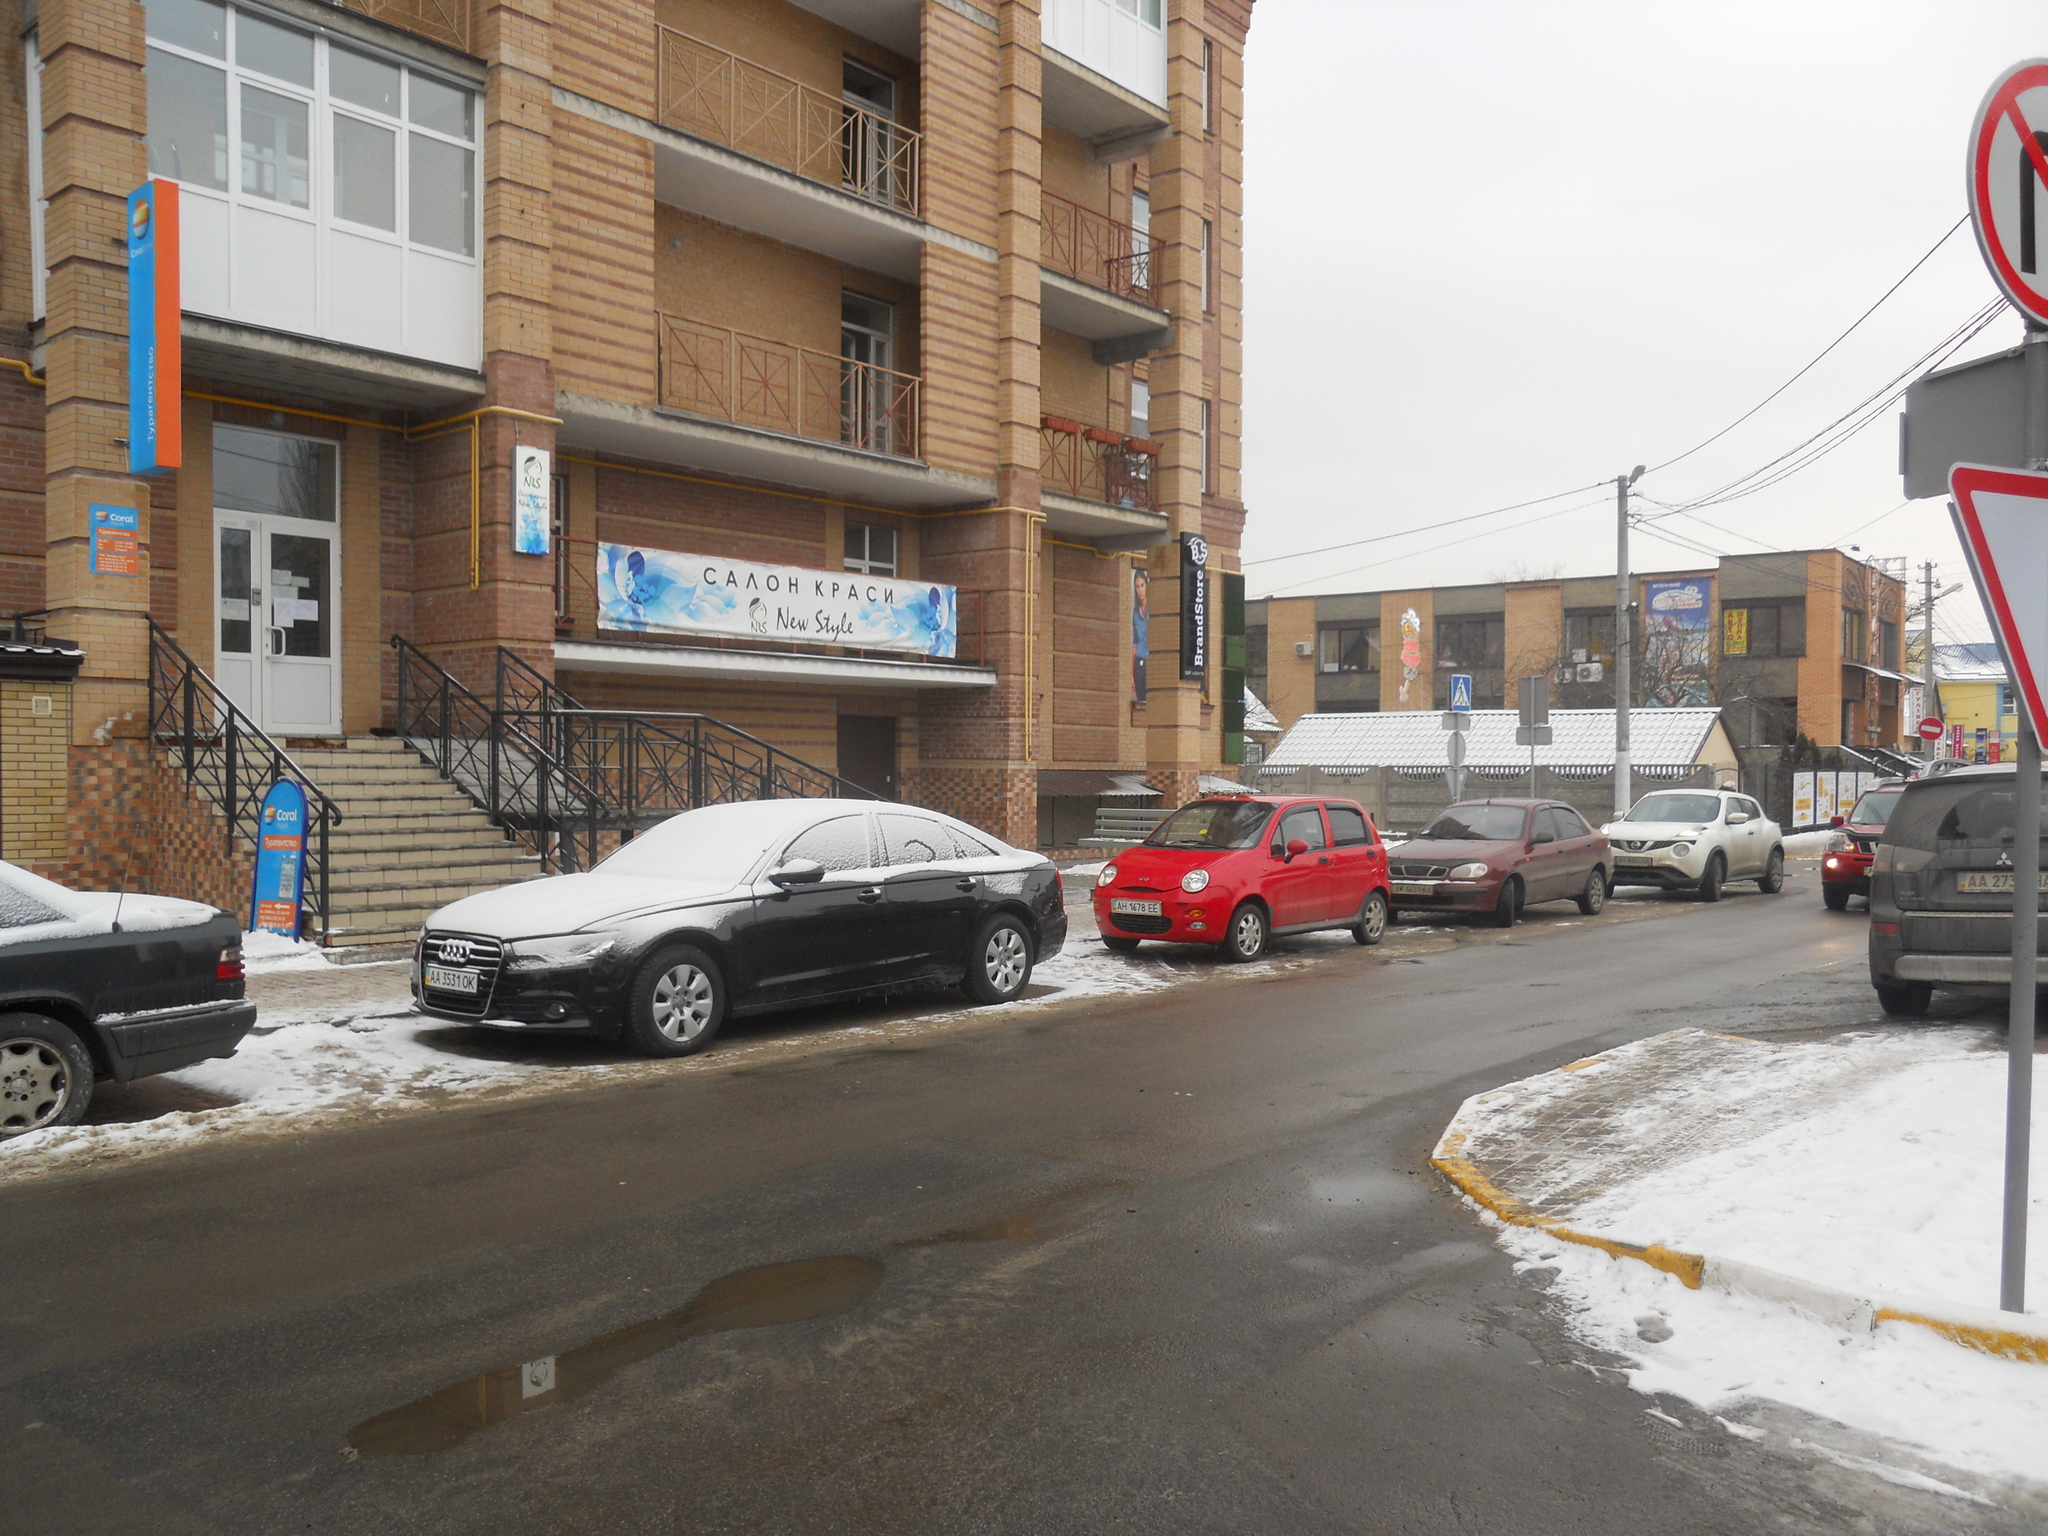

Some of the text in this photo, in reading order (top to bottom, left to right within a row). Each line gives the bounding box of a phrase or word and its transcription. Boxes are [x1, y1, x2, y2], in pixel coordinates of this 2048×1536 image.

[147, 346, 156, 444] Турагентство
[110, 513, 134, 523] Coral
[703, 567, 894, 603] САЛОН КРАСИ
[776, 606, 854, 642] New Style
[1194, 569, 1204, 667] BrandStore
[277, 809, 298, 822] Coral
[265, 838, 297, 848] Турагентство
[1967, 875, 1987, 888] AA
[1117, 902, 1158, 913] AH 1678 EE
[430, 970, 476, 990] AA 3531 OK
